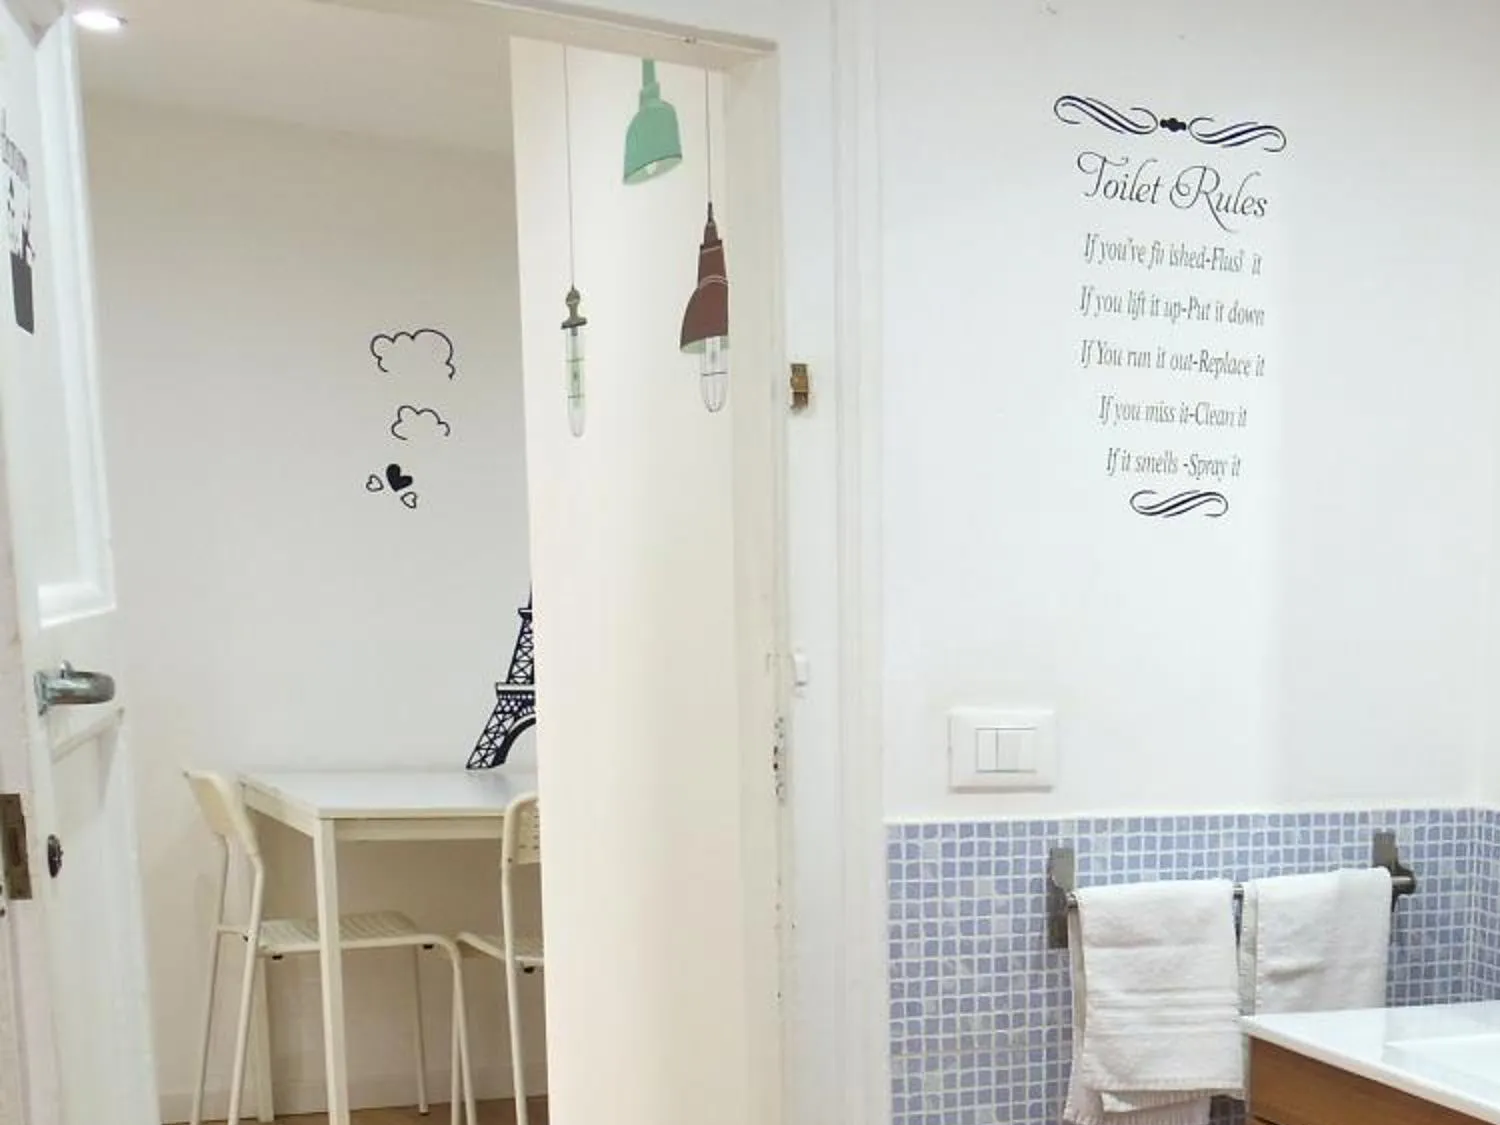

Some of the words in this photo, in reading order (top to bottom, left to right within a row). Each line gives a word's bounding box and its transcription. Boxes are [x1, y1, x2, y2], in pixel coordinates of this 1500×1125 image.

[1077, 151, 1163, 205] Toilet
[1169, 165, 1268, 234] Rules
[1084, 232, 1099, 264] If
[1098, 238, 1146, 265] you've
[1252, 253, 1262, 275] it
[1080, 285, 1095, 316] If
[1094, 293, 1121, 317] you
[1127, 289, 1146, 320] lift
[1150, 293, 1160, 315] it
[1216, 300, 1226, 322] it
[1228, 301, 1265, 326] down
[1080, 339, 1094, 369] If
[1096, 340, 1122, 367] You
[1127, 350, 1151, 369] run
[1156, 347, 1166, 369] it
[1256, 354, 1266, 377] it
[1099, 395, 1115, 426] If
[1113, 402, 1140, 426] you
[1145, 401, 1175, 423] miss
[1237, 405, 1248, 428] it
[1106, 447, 1121, 477] If
[1122, 450, 1131, 473] it
[1135, 450, 1178, 474] smells
[1231, 454, 1241, 477] it
